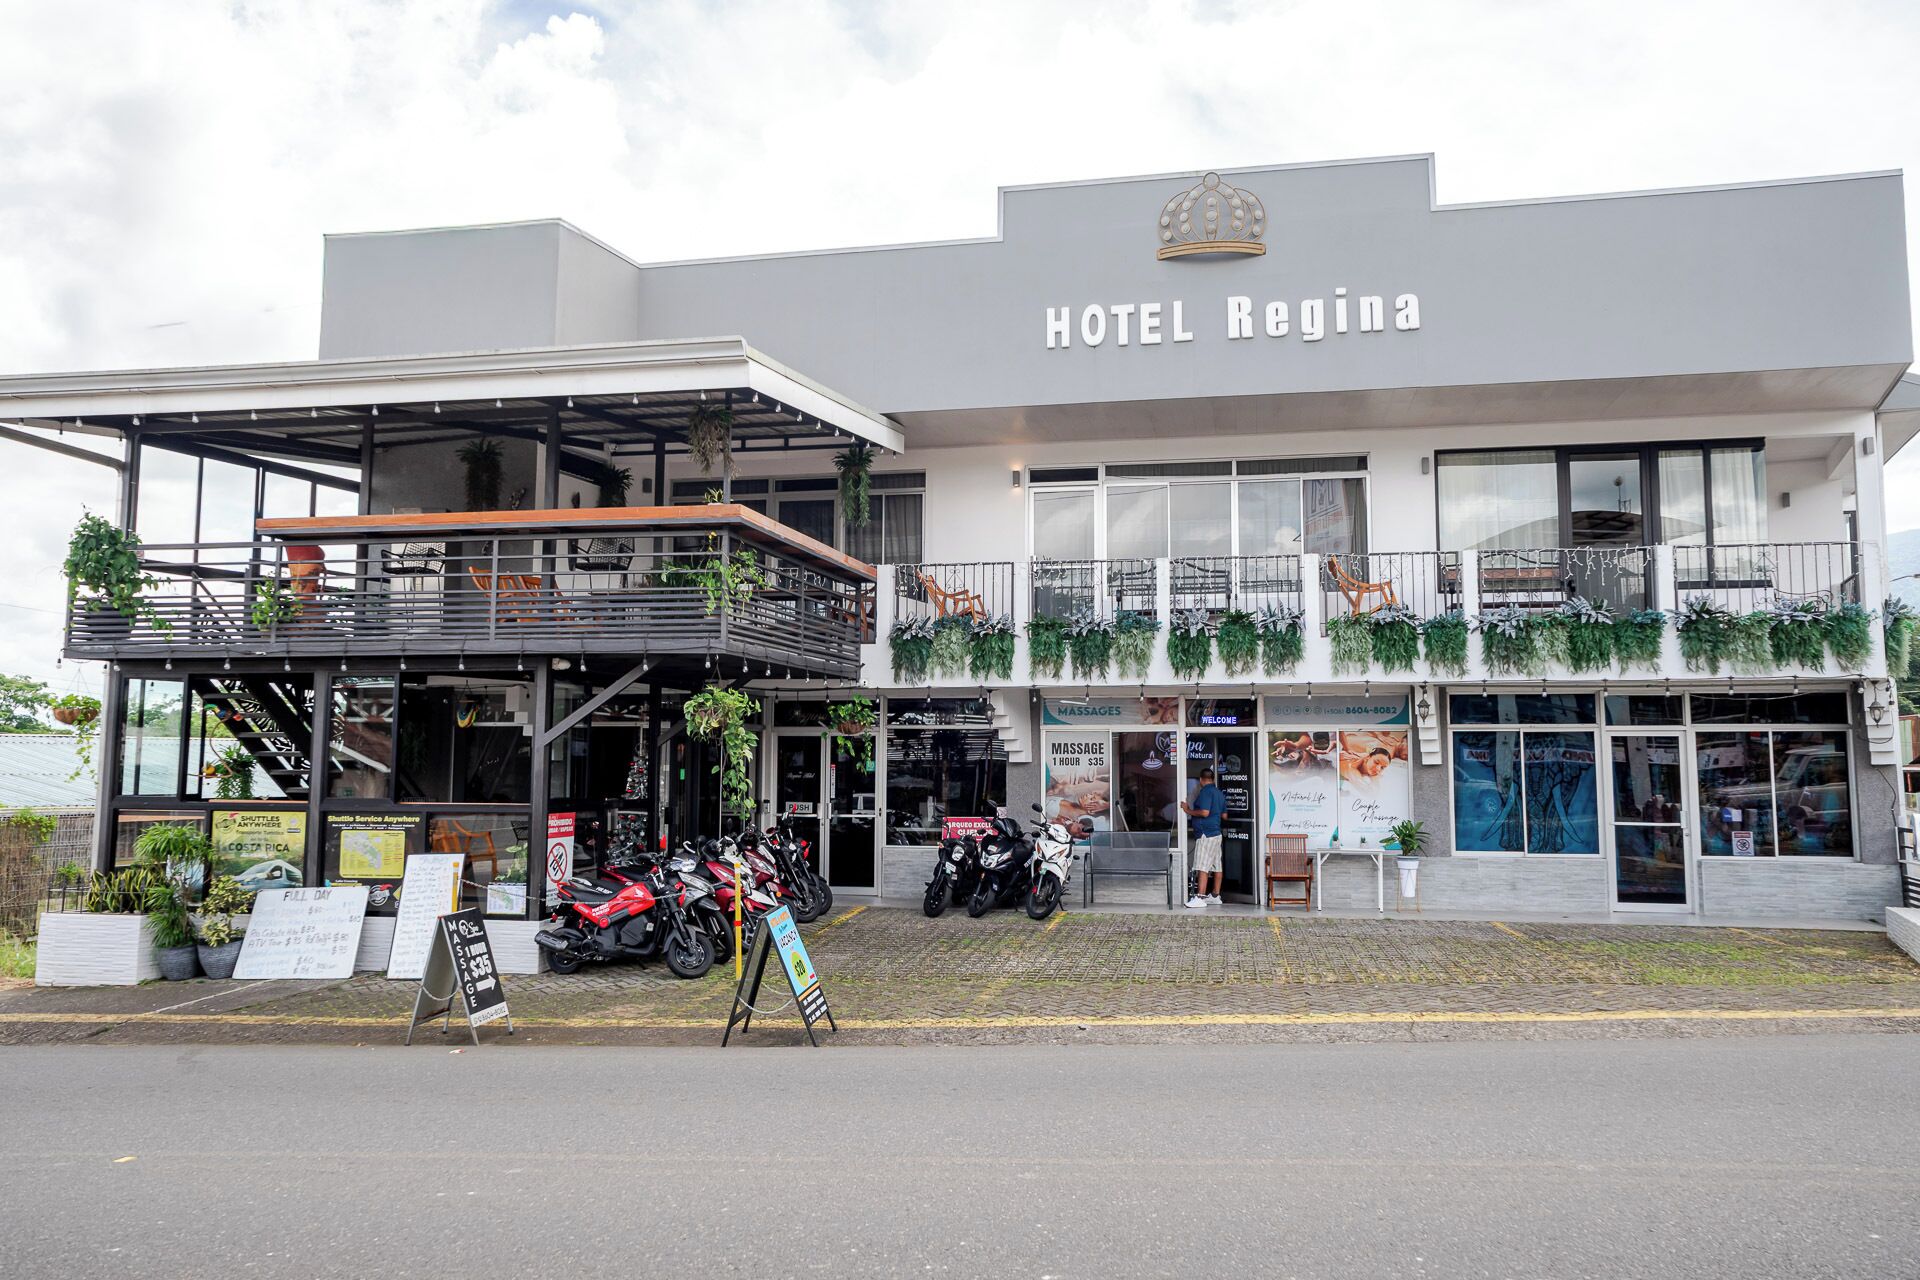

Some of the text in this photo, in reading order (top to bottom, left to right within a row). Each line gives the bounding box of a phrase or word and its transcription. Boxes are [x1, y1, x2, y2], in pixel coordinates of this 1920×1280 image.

[1046, 287, 1421, 349] HOTEL Regina
[1057, 705, 1122, 716] MASSAGES
[1345, 706, 1398, 715] 8604-8082
[1201, 716, 1237, 725] WELCOME
[1051, 742, 1105, 755] MASSAGE
[1053, 757, 1104, 766] 1 HOUR $35
[1281, 791, 1311, 802] Natural
[1351, 798, 1381, 812] Couple
[383, 815, 420, 823] Anywhere
[1361, 811, 1400, 826] Massage
[228, 842, 290, 852] COSTA RICA
[283, 890, 333, 902] FULL DAY
[464, 946, 471, 958] 1
[447, 920, 477, 1008] MASSAGE
[469, 954, 493, 979] $35
[794, 959, 806, 978] $20
